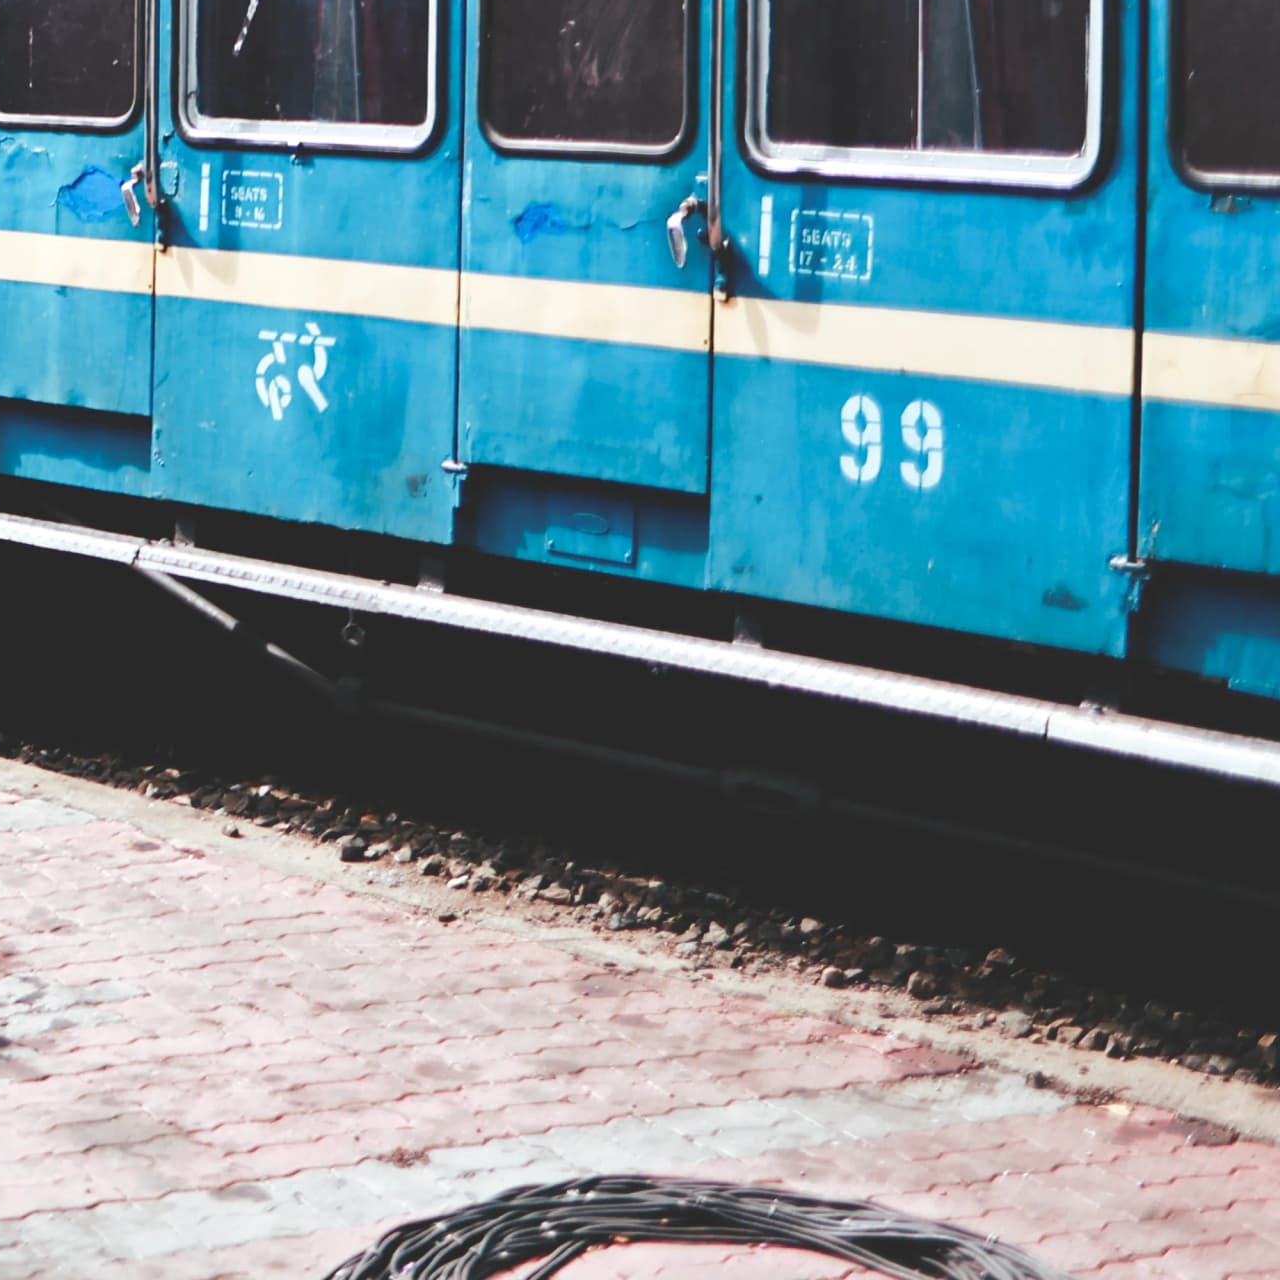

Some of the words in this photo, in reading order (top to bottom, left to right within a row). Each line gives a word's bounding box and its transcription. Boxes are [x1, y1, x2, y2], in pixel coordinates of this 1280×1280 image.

[230, 186, 268, 202] SEATS
[801, 228, 851, 249] SEATS
[840, 394, 943, 489] 99
